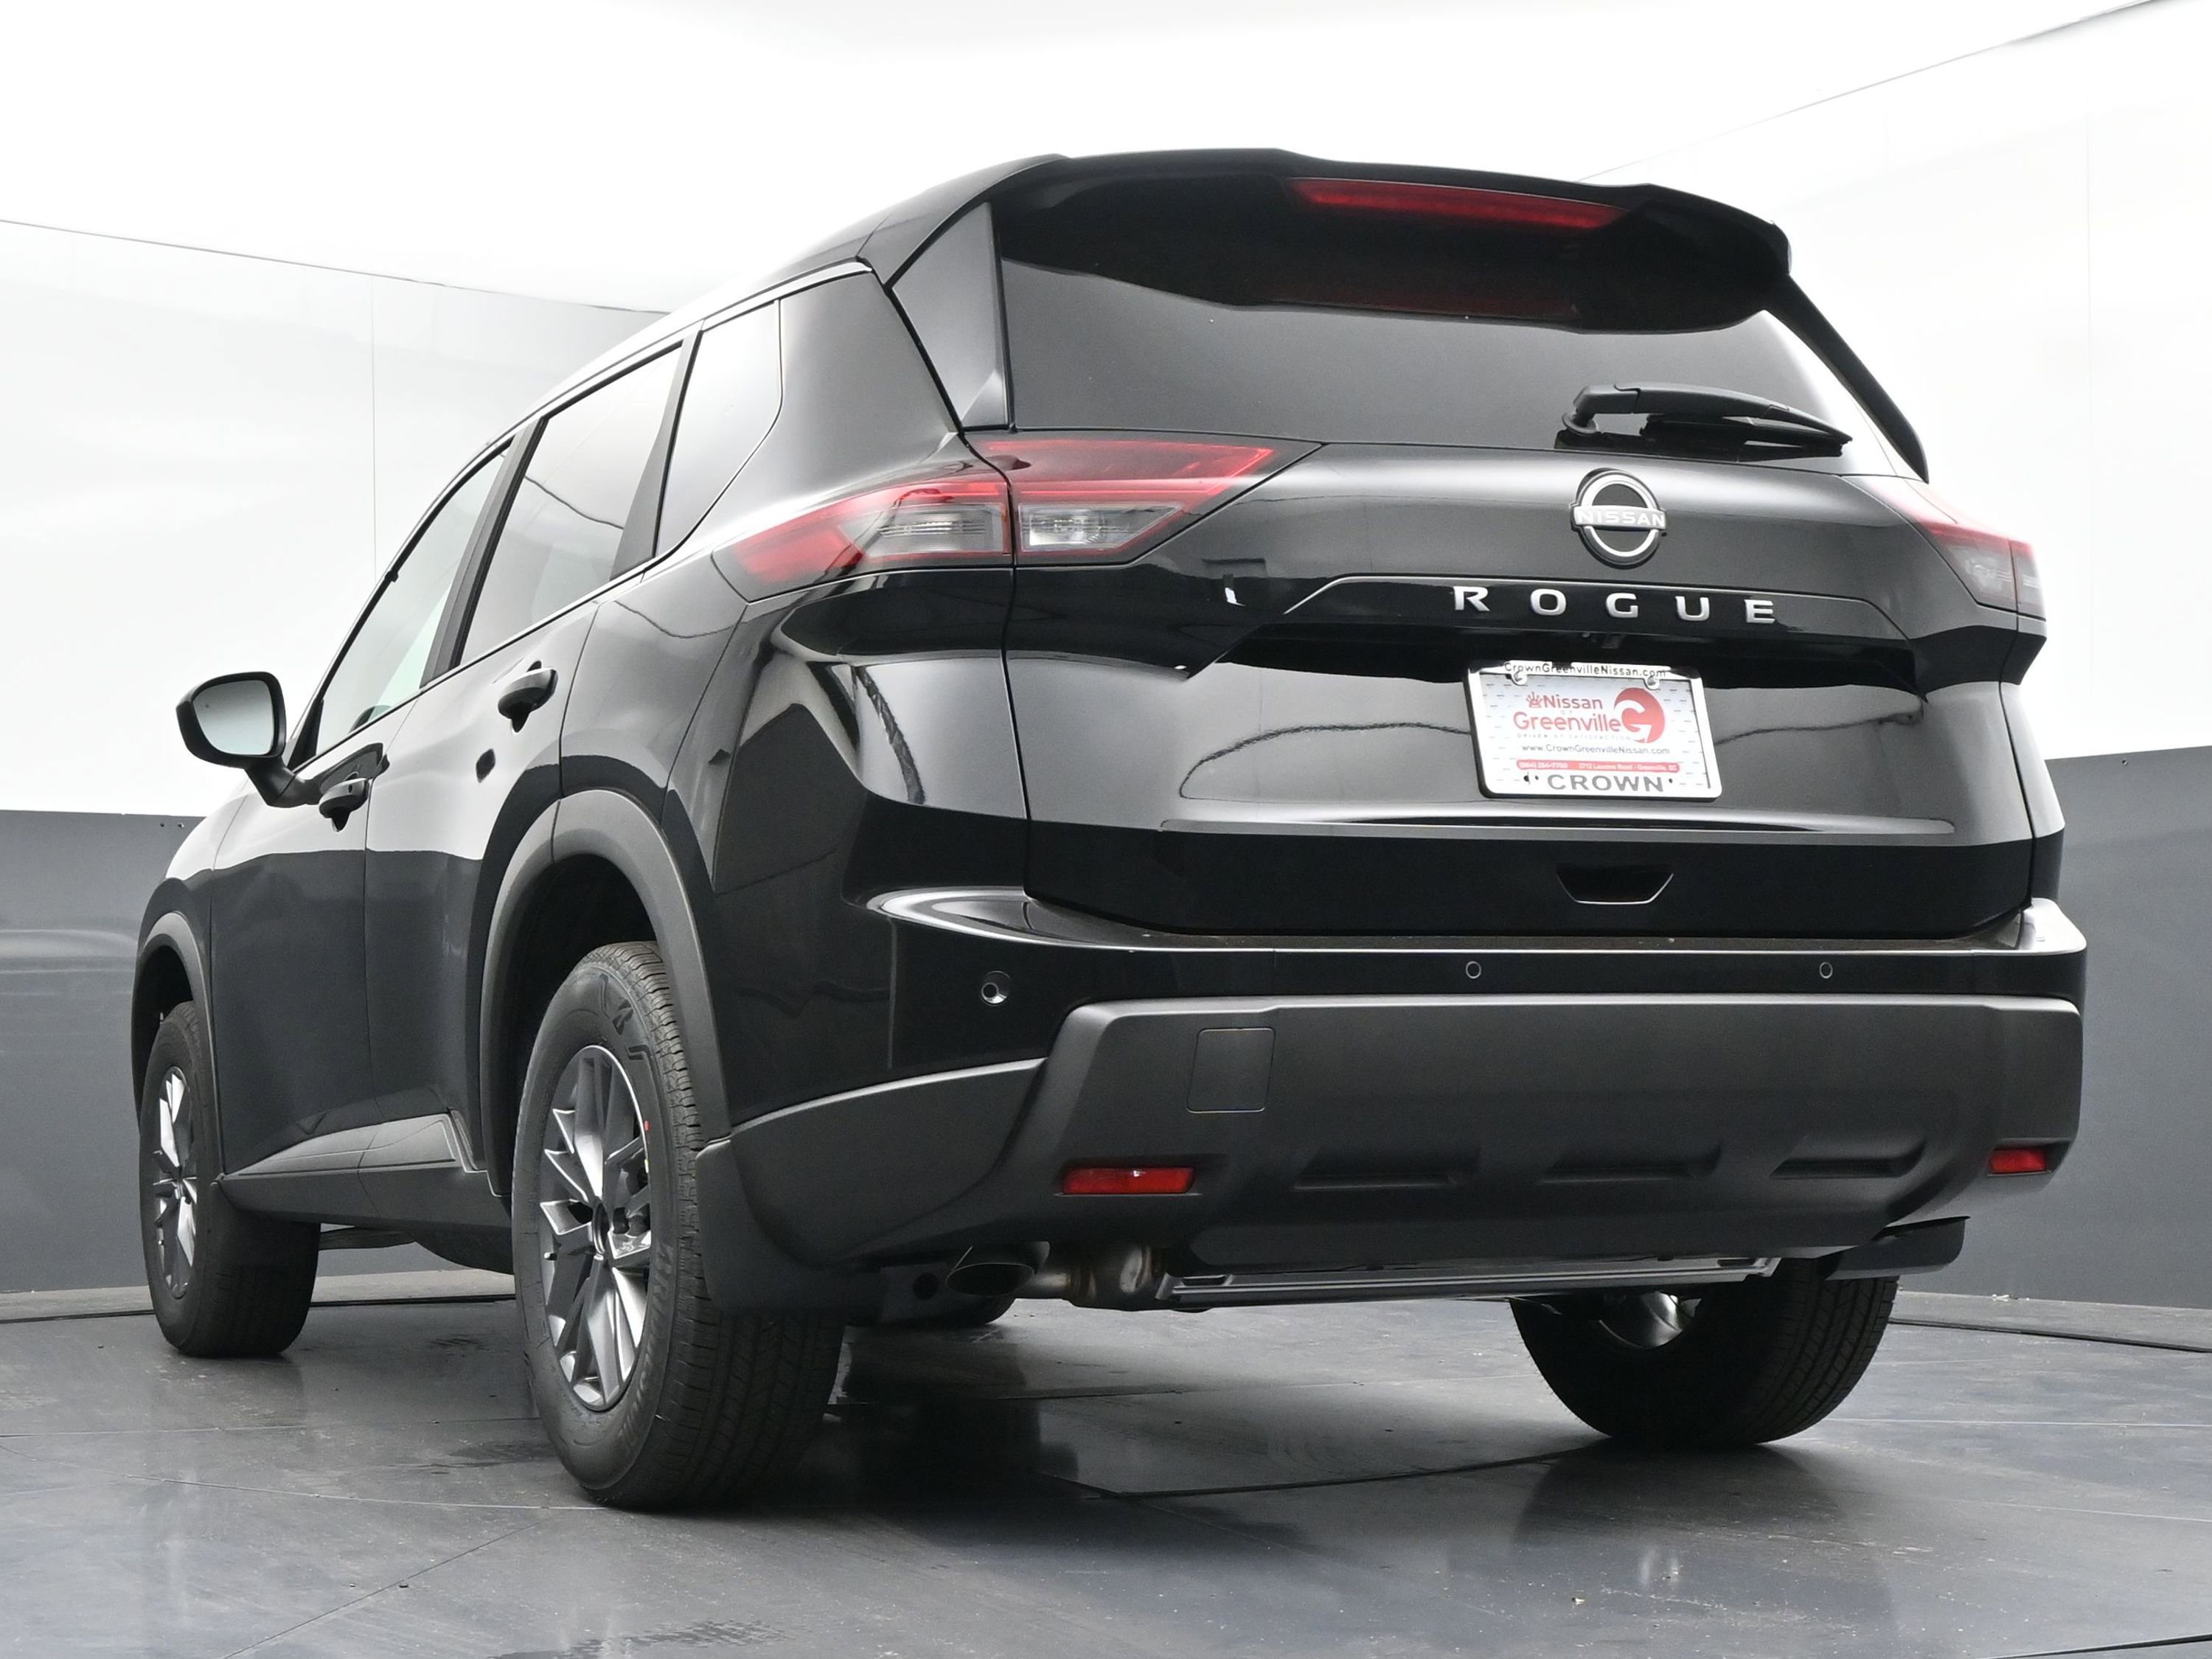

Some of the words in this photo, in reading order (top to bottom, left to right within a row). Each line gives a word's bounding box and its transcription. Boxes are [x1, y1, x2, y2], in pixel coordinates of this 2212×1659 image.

[1575, 508, 1666, 527] NISSAN
[1453, 585, 1775, 624] ROGUE
[1504, 661, 1666, 677] CrownGreenvilleNissan.com
[1543, 693, 1603, 710] Nissan
[1513, 711, 1622, 732] Greenville
[1547, 774, 1663, 793] CROWN
